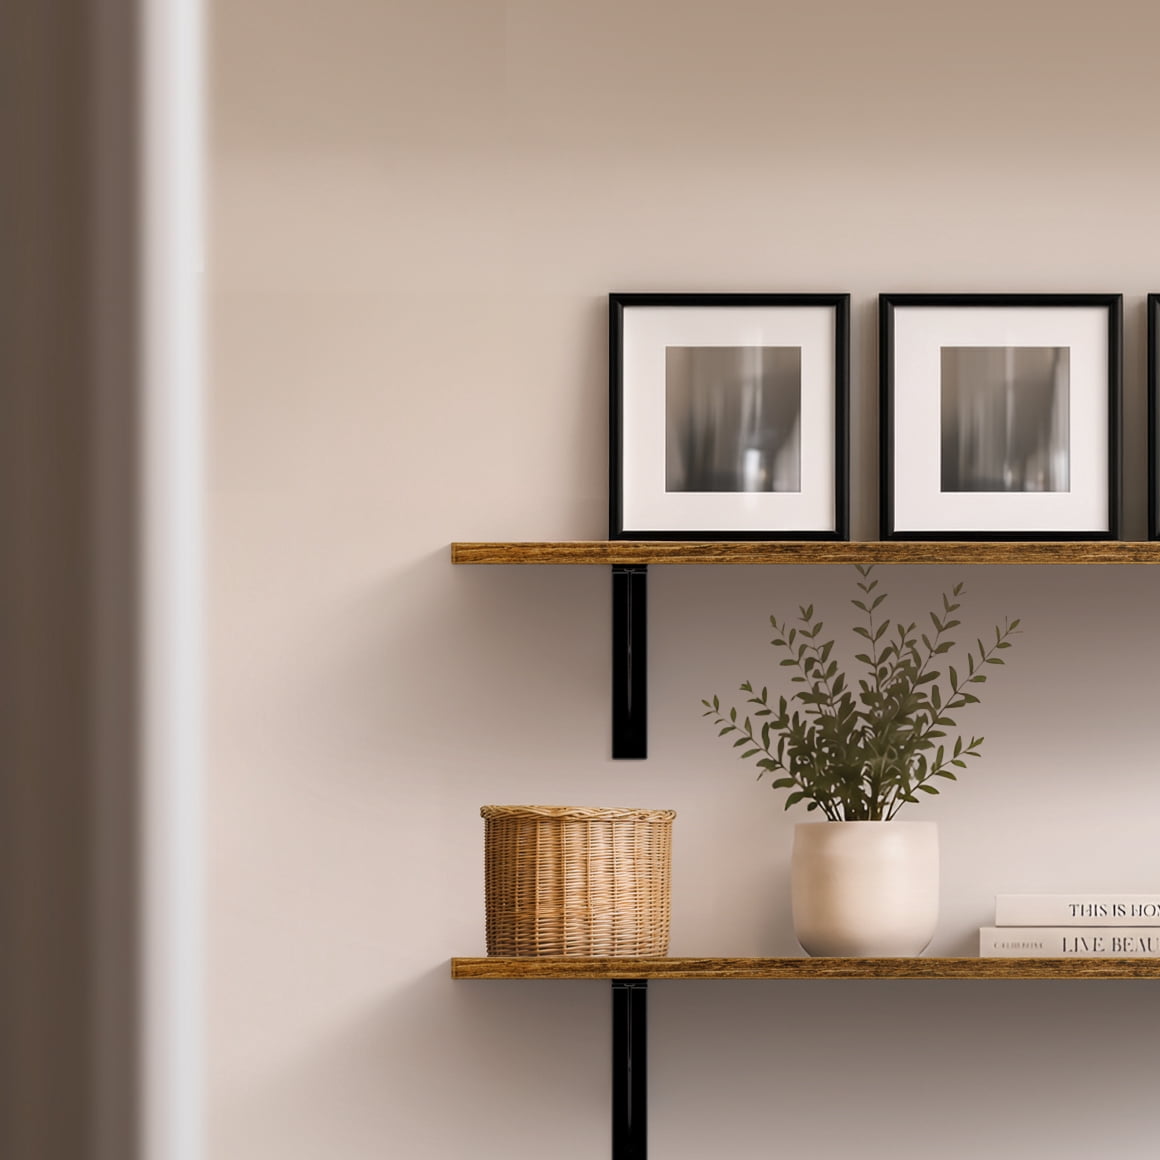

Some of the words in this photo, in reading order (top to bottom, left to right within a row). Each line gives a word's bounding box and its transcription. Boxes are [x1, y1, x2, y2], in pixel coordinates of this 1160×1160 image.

[1068, 903, 1108, 918] THIS
[1112, 903, 1126, 918] IS
[1062, 936, 1105, 953] LIVE
